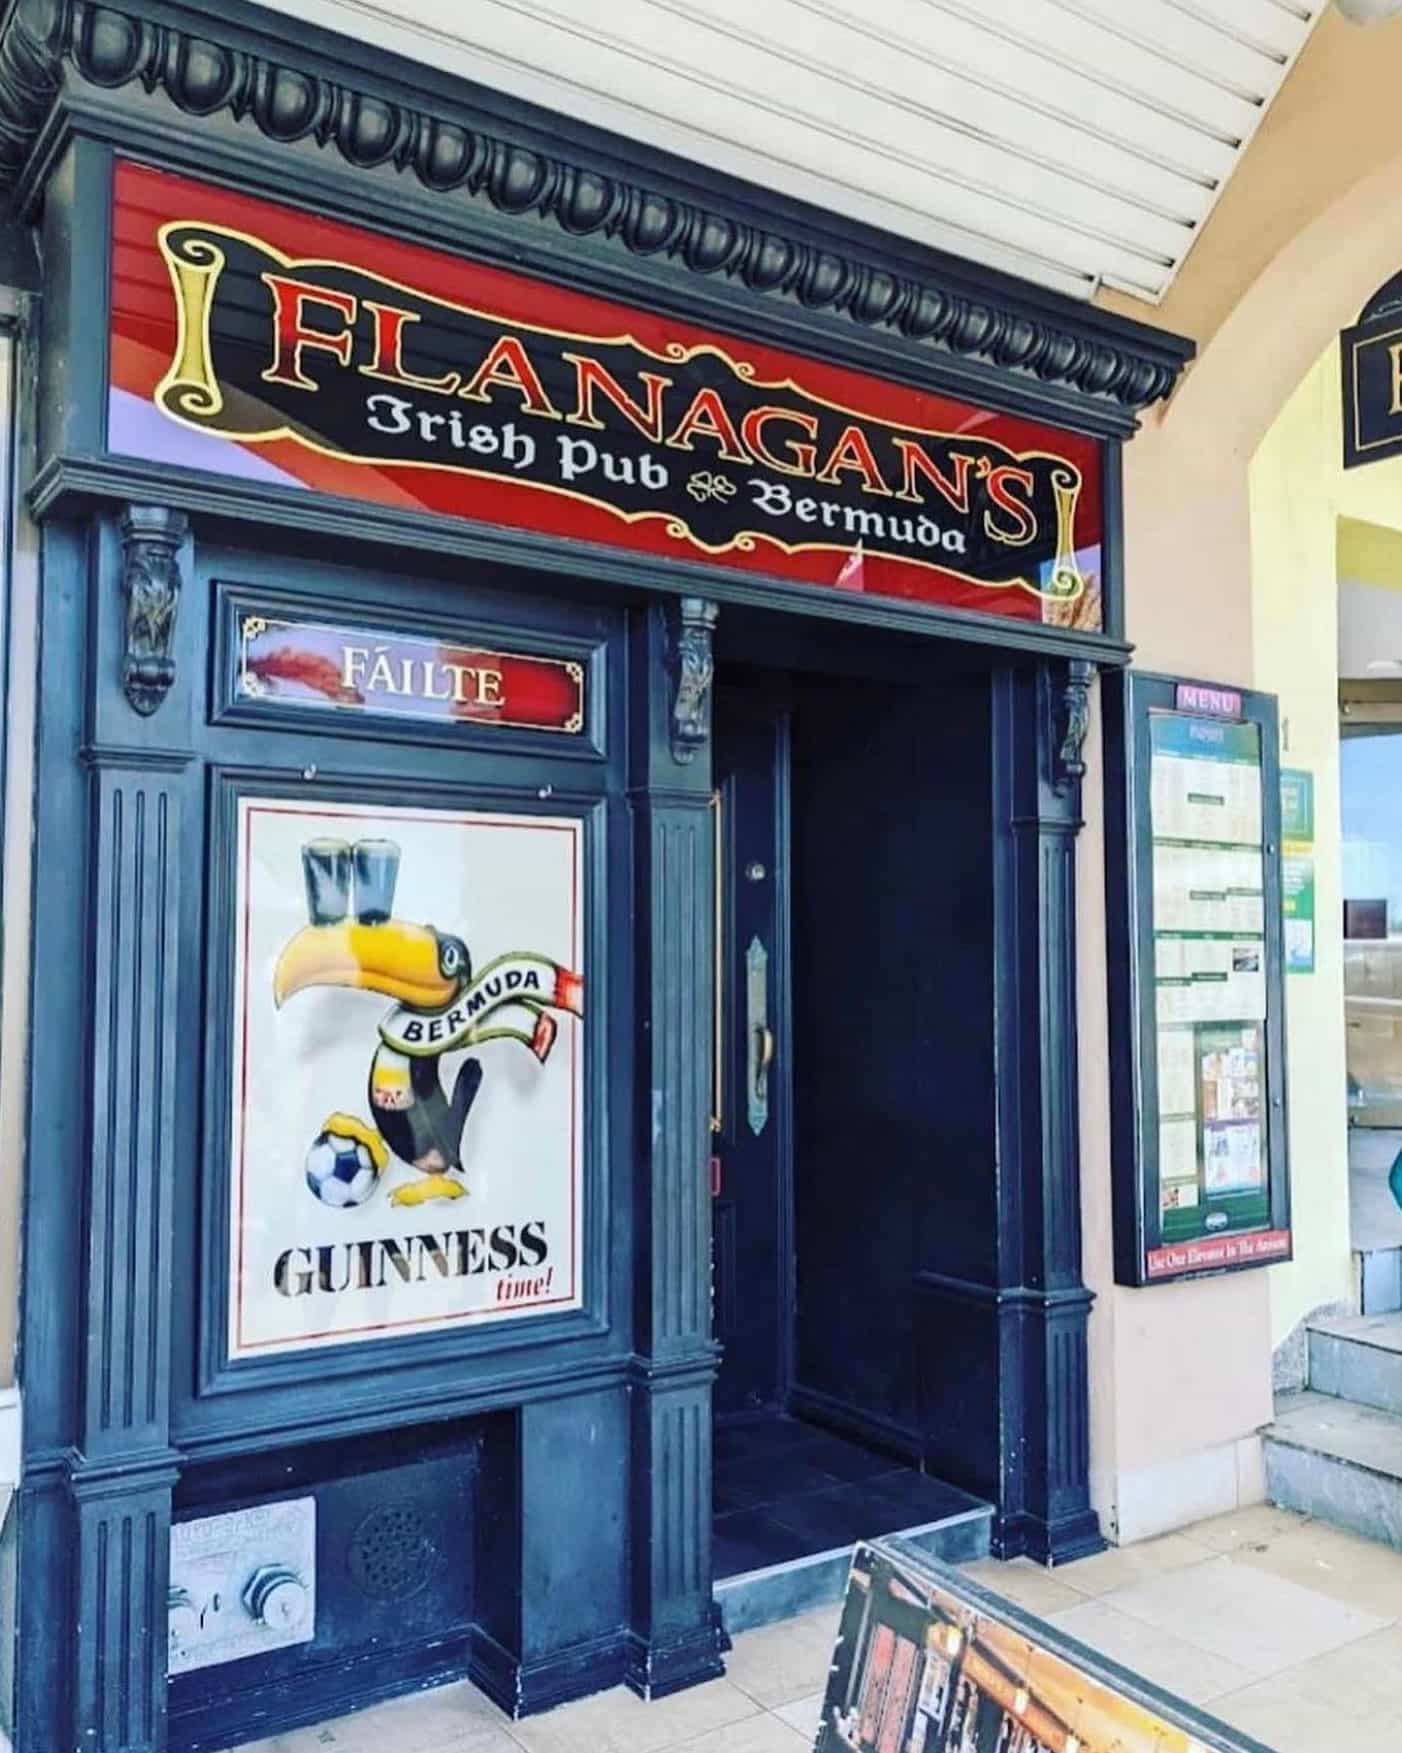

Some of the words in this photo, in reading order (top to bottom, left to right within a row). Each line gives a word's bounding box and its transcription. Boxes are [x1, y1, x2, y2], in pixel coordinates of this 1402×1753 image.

[261, 271, 1038, 547] FLANAGAN'S
[366, 394, 536, 469] Irish
[747, 478, 967, 554] Bermuda
[341, 645, 506, 706] FÁILTE
[1182, 686, 1235, 713] MENU
[402, 970, 540, 1043] BERMUDA
[273, 1221, 549, 1298] GUINNESS
[496, 1266, 553, 1301] time!
